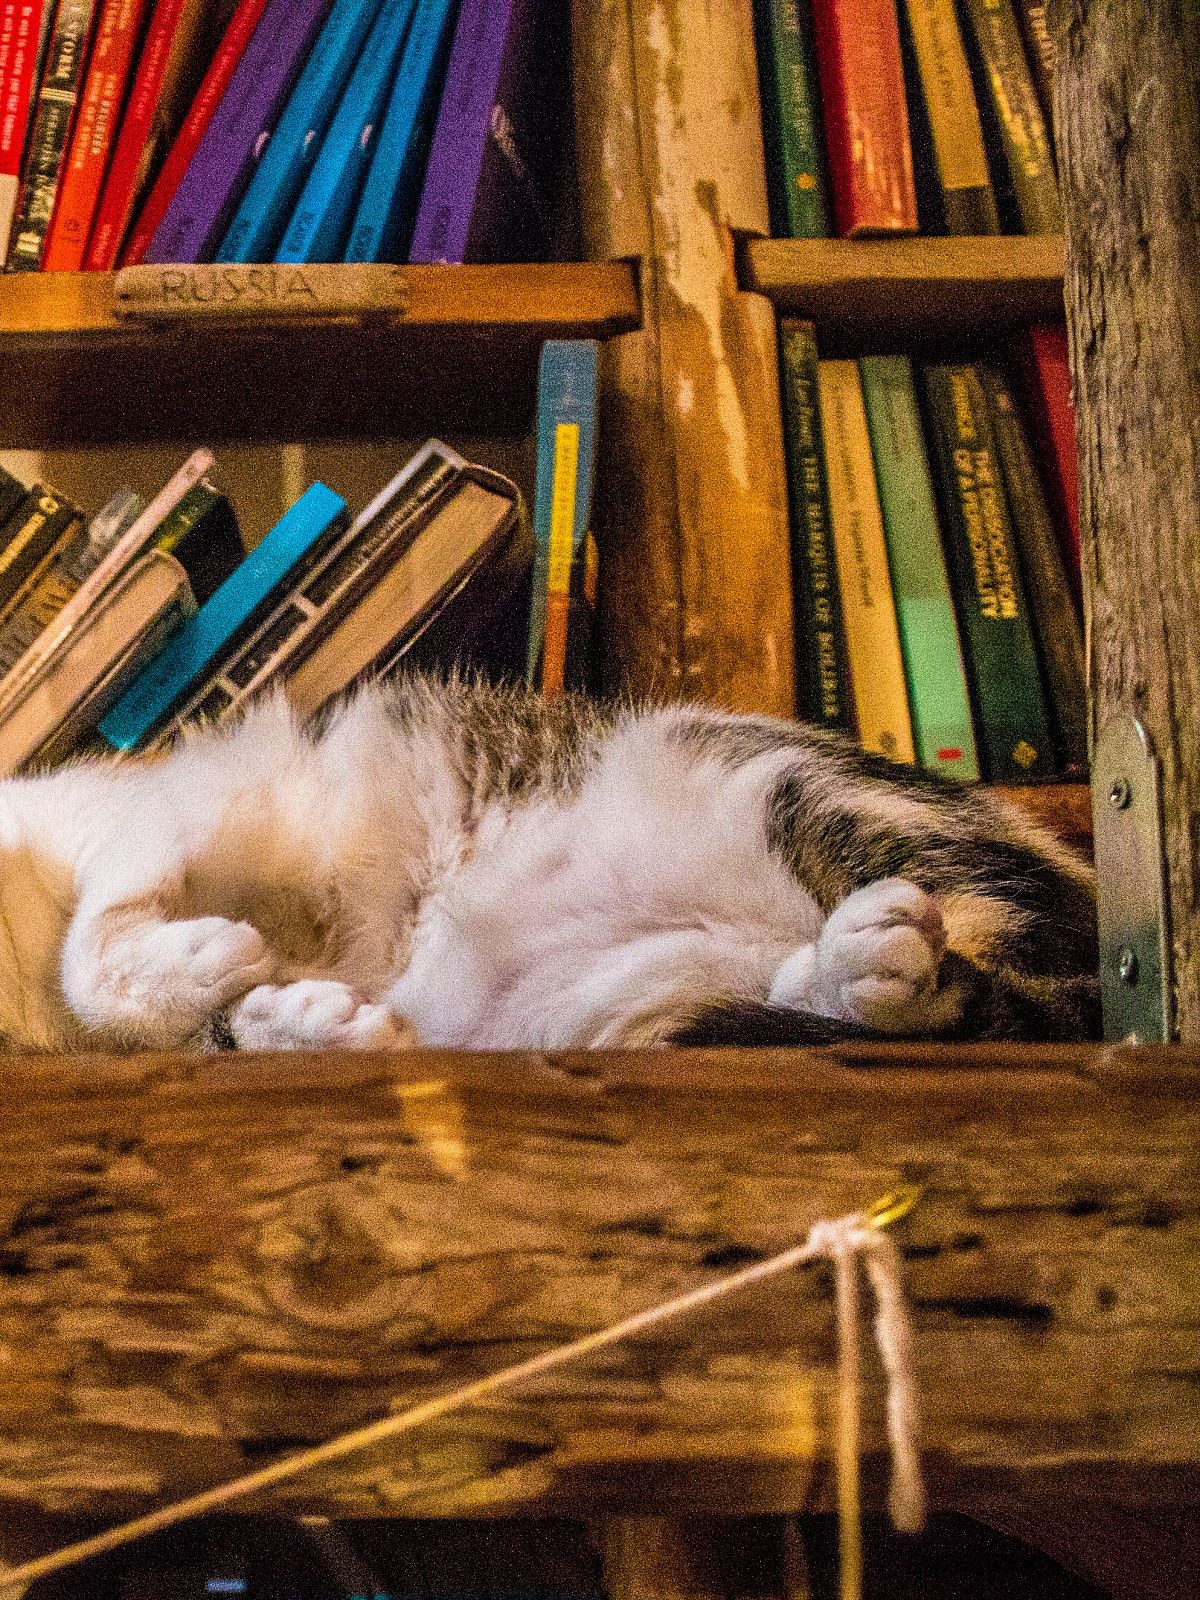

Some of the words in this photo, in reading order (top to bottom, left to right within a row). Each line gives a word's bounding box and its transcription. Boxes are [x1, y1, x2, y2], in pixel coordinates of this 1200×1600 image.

[54, 22, 79, 79] STORM
[160, 268, 318, 302] RUSSIA
[802, 455, 819, 492] THE
[803, 501, 827, 591] MARQUIS
[812, 596, 829, 624] OF
